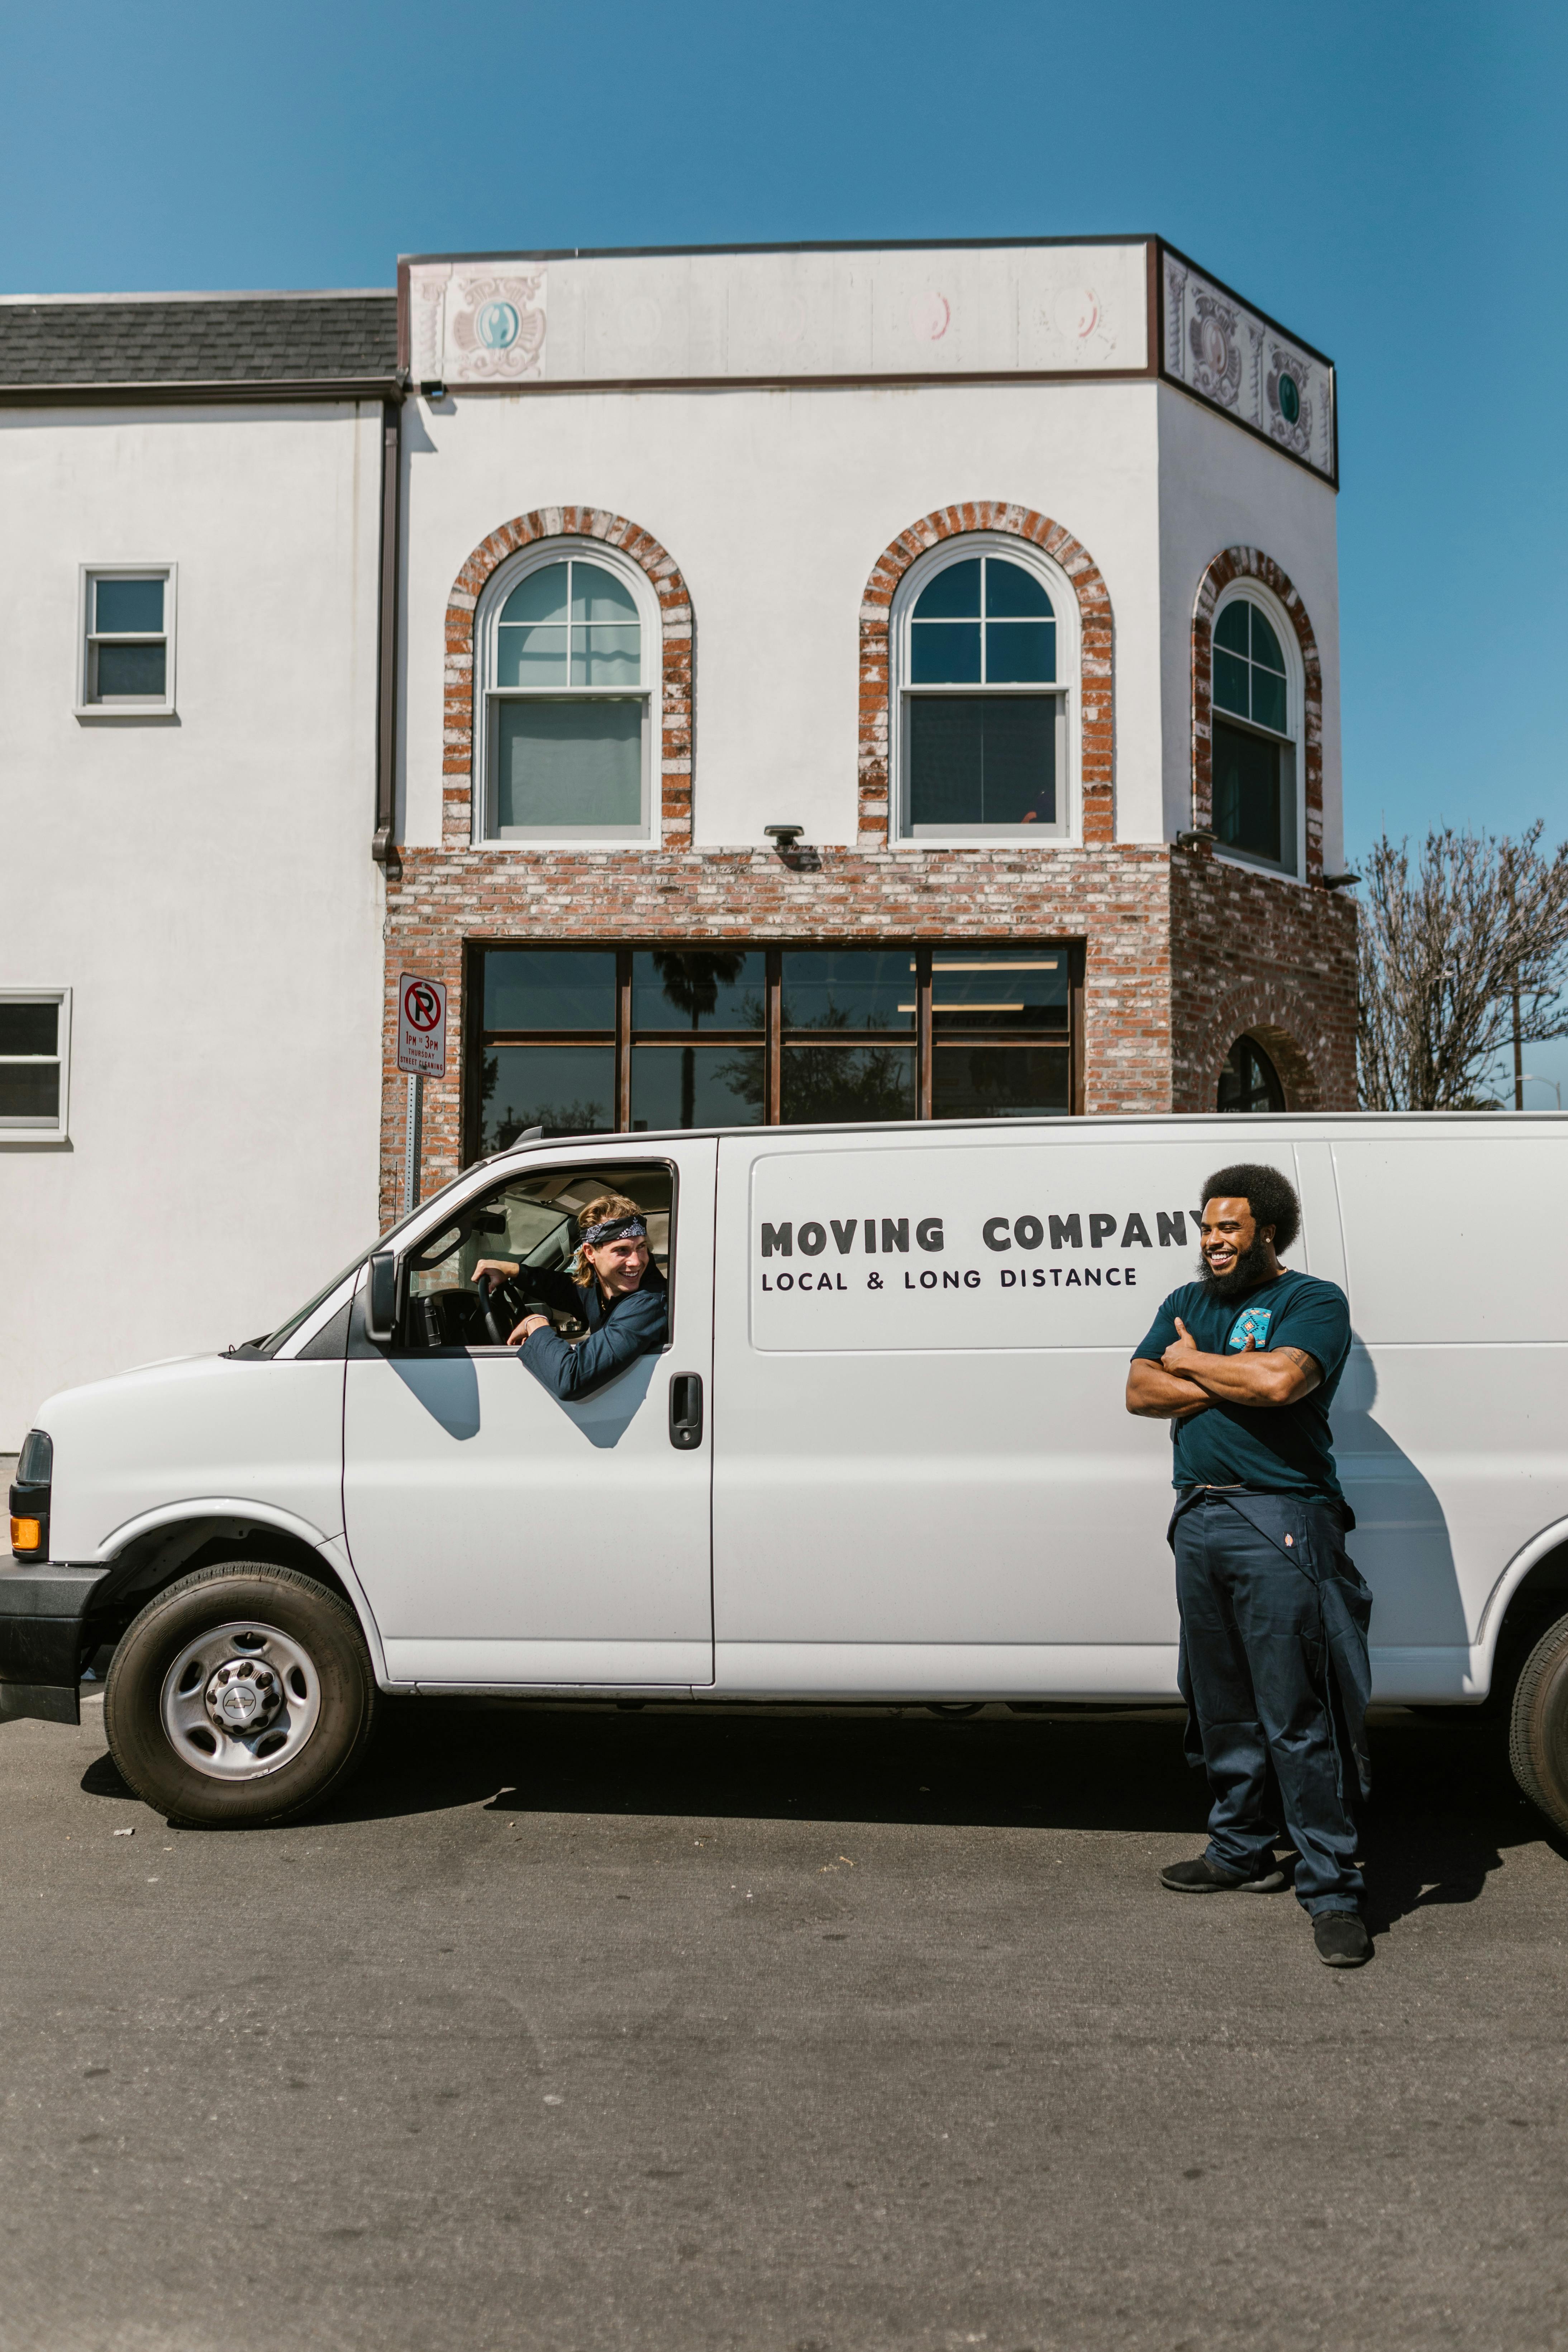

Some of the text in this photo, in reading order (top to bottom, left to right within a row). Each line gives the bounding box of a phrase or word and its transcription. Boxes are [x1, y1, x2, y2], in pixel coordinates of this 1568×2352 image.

[406, 1031, 416, 1046] 1PM
[425, 1035, 438, 1051] 3PM
[400, 1056, 443, 1071] STREET CLEANING
[409, 1048, 435, 1060] THURSDAY
[761, 1217, 944, 1258] MOVING
[762, 1267, 1137, 1291] LOCAL & LONG DISTANCE
